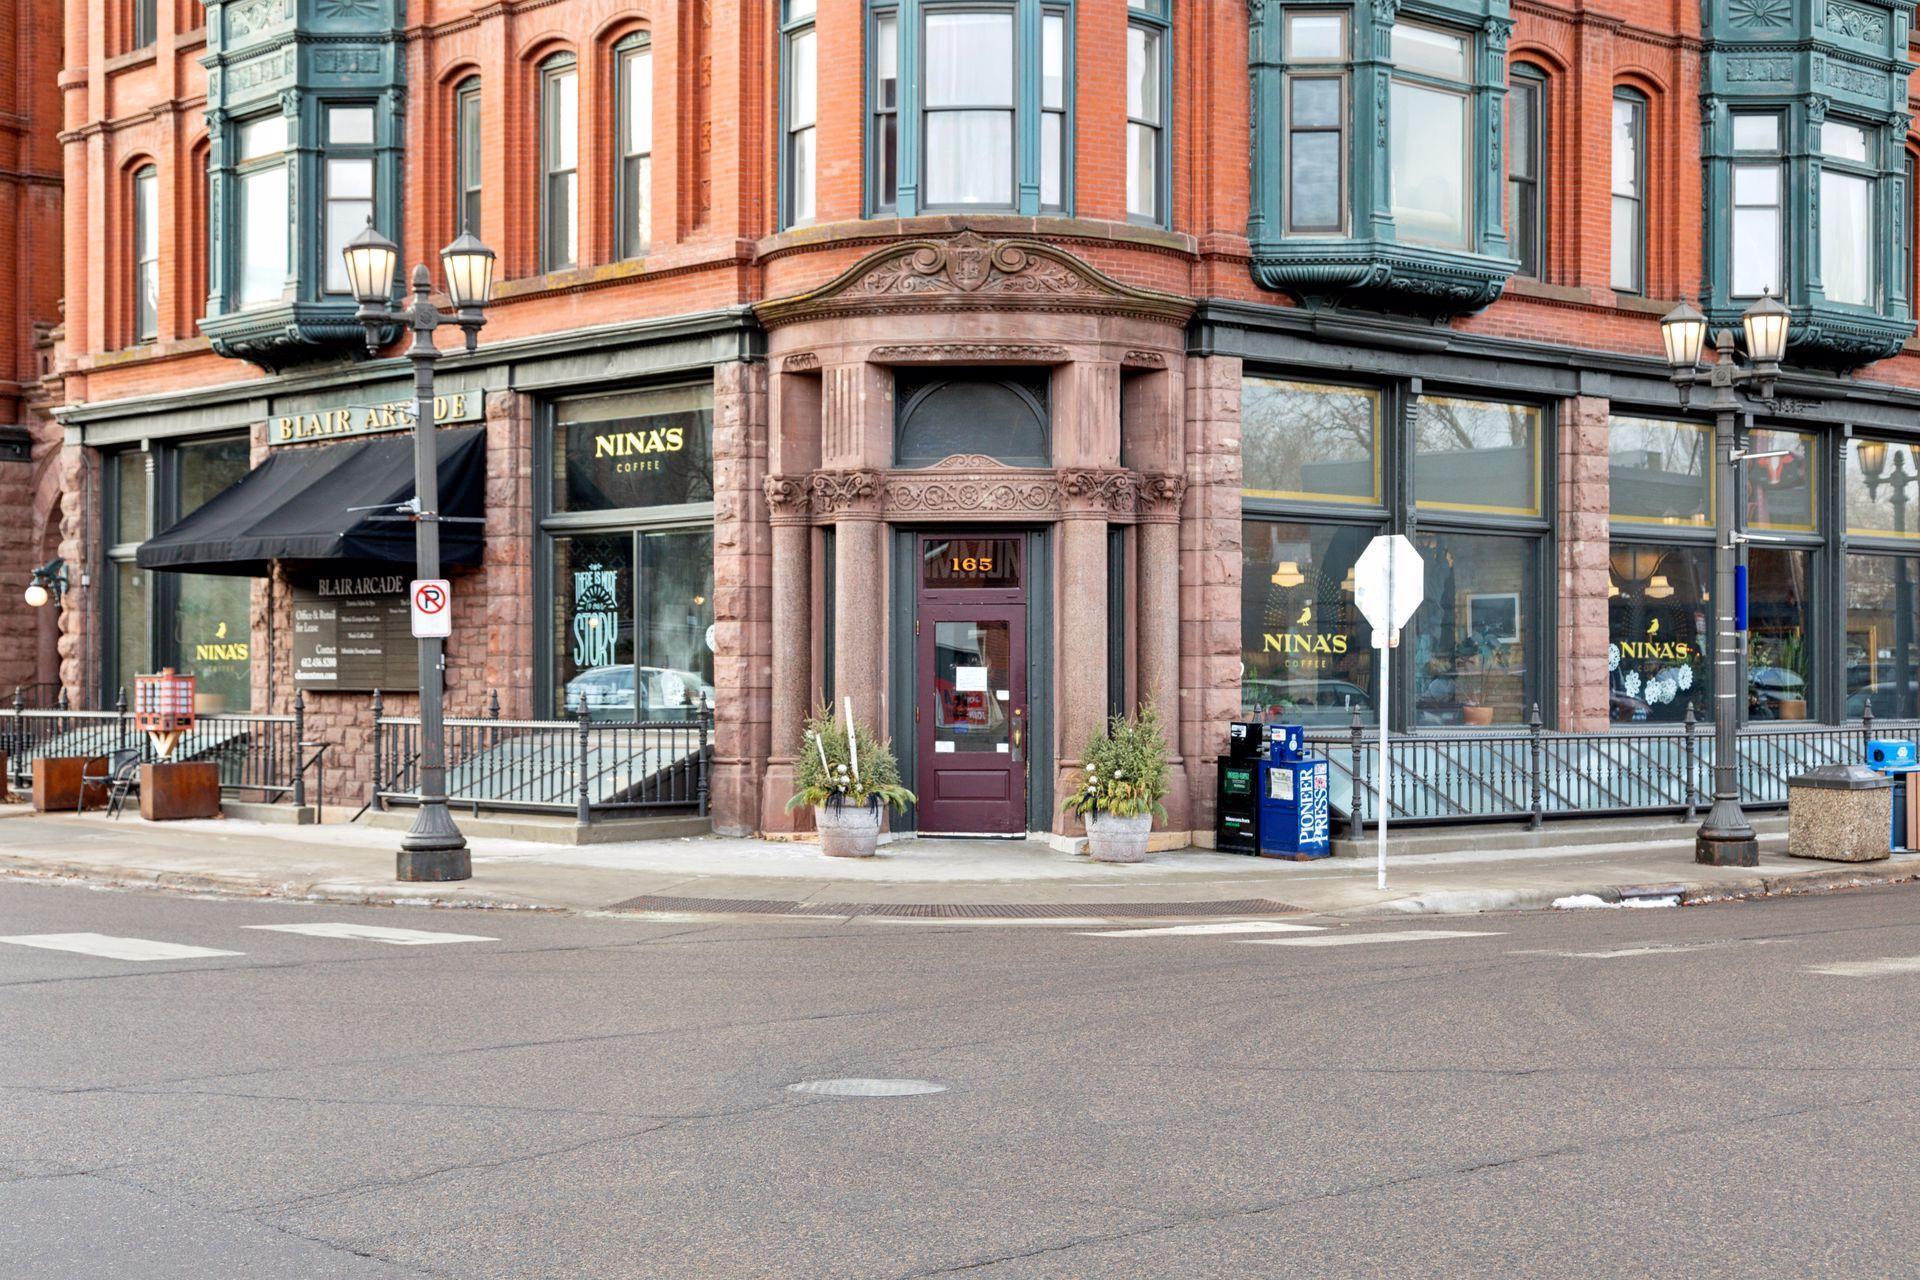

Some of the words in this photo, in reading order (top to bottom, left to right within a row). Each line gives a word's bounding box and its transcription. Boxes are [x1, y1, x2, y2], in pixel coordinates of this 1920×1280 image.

[279, 409, 352, 440] BLAIR
[364, 394, 467, 429] ARCDE
[595, 427, 684, 458] NINA'S
[616, 460, 660, 473] COFFEE
[952, 557, 993, 571] 165
[318, 578, 353, 596] BLAIR
[354, 576, 404, 595] ARCADE
[574, 611, 618, 666] STORY
[1262, 633, 1348, 654] NINA'S
[196, 643, 249, 661] NINA'S
[1620, 641, 1688, 659] NINA'S
[1284, 659, 1327, 668] COFFEE
[1299, 767, 1315, 845] PIONEER
[1313, 787, 1329, 846] PRESS
